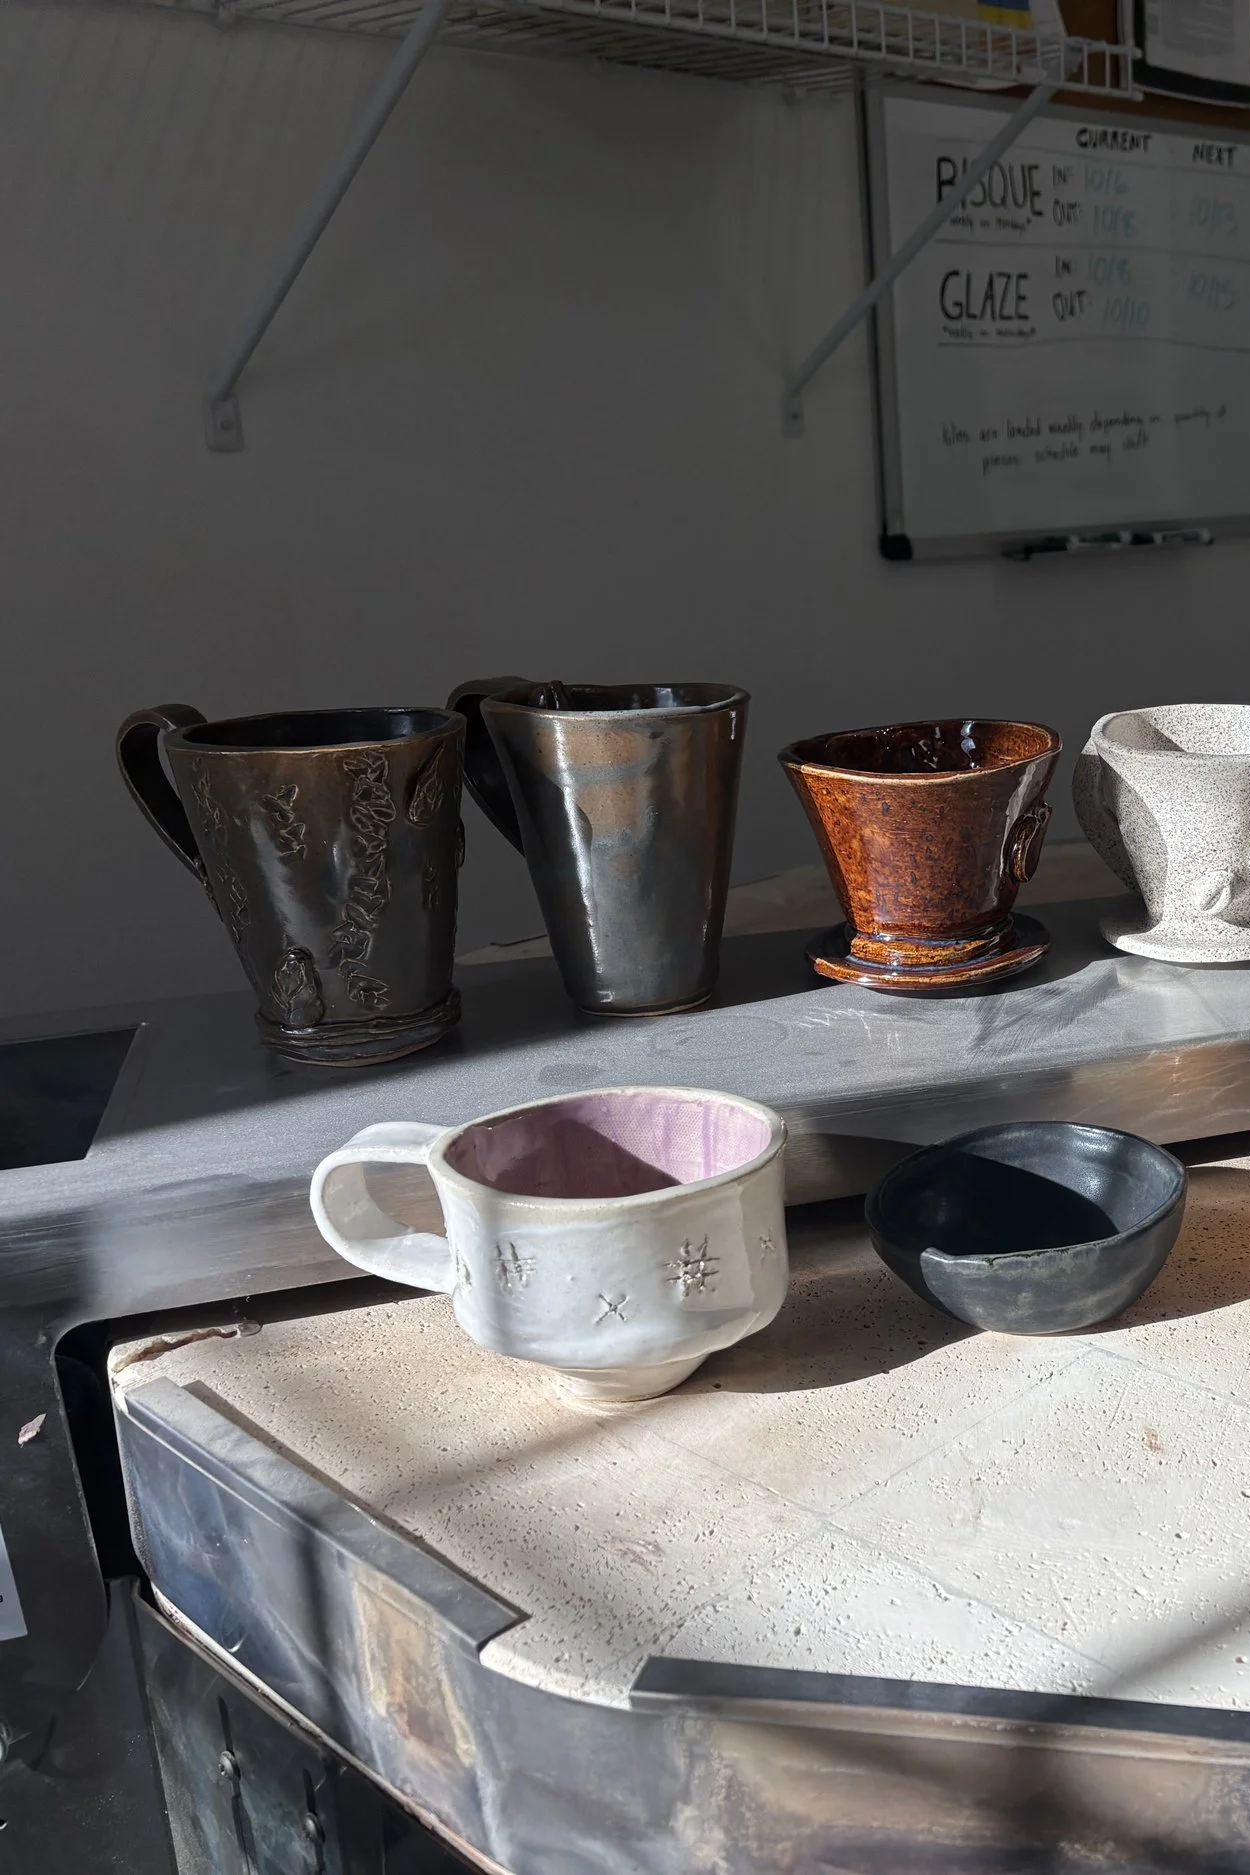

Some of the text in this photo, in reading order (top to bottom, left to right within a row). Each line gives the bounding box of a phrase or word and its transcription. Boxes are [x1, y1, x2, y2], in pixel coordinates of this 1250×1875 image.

[1076, 126, 1152, 153] CURRENT
[1192, 143, 1238, 169] NEXT
[1084, 164, 1130, 195] 10/6
[1093, 204, 1137, 239] 10/8
[938, 268, 1032, 323] GLAZE
[1101, 294, 1150, 331] 10/10
[1006, 415, 1041, 439] loaded
